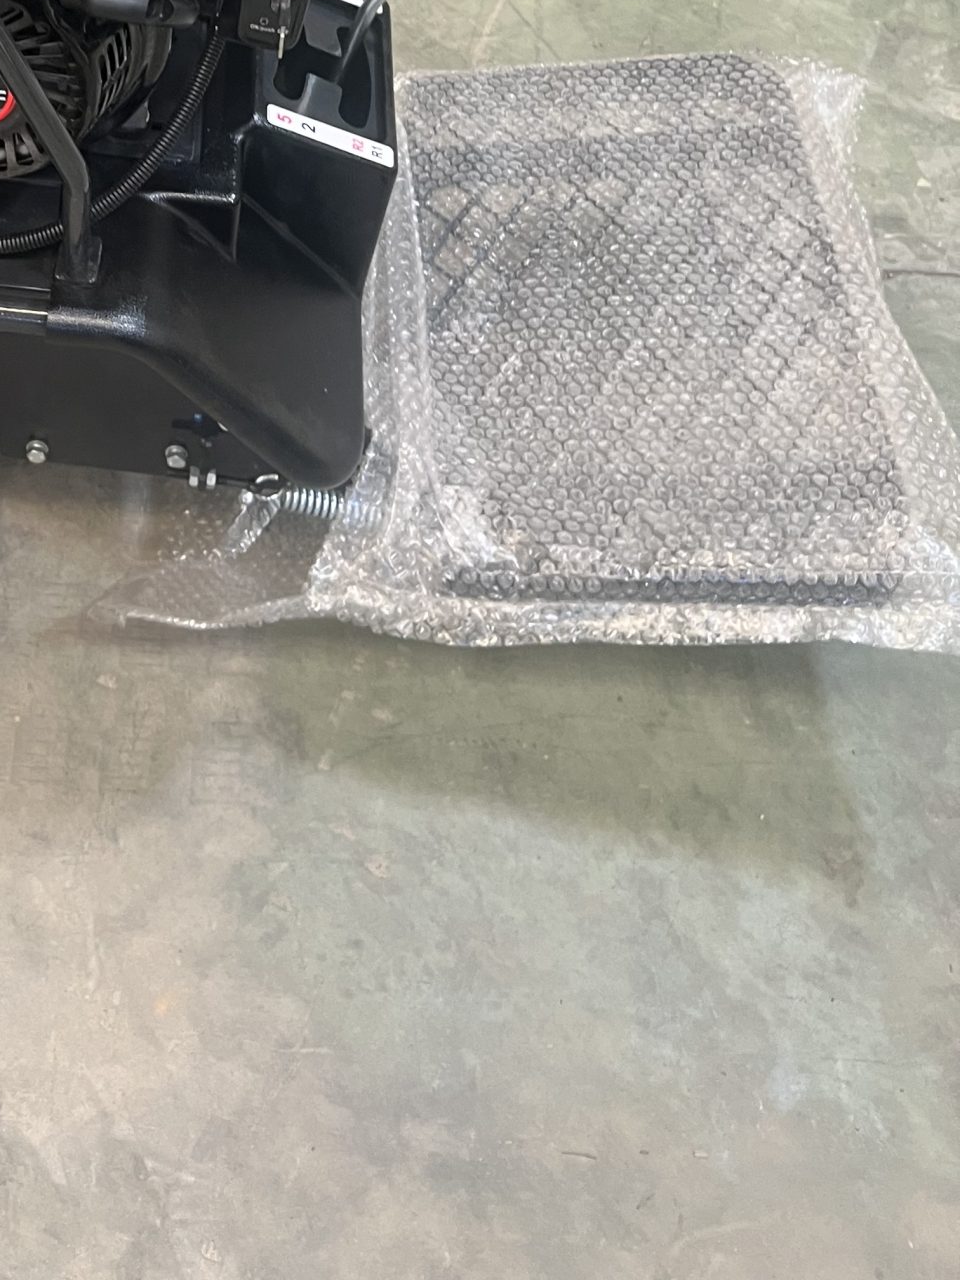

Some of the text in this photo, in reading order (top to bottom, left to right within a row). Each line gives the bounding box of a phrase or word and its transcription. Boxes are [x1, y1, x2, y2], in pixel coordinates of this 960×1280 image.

[277, 112, 292, 125] 5
[301, 122, 316, 133] 2
[371, 144, 383, 159] R1
